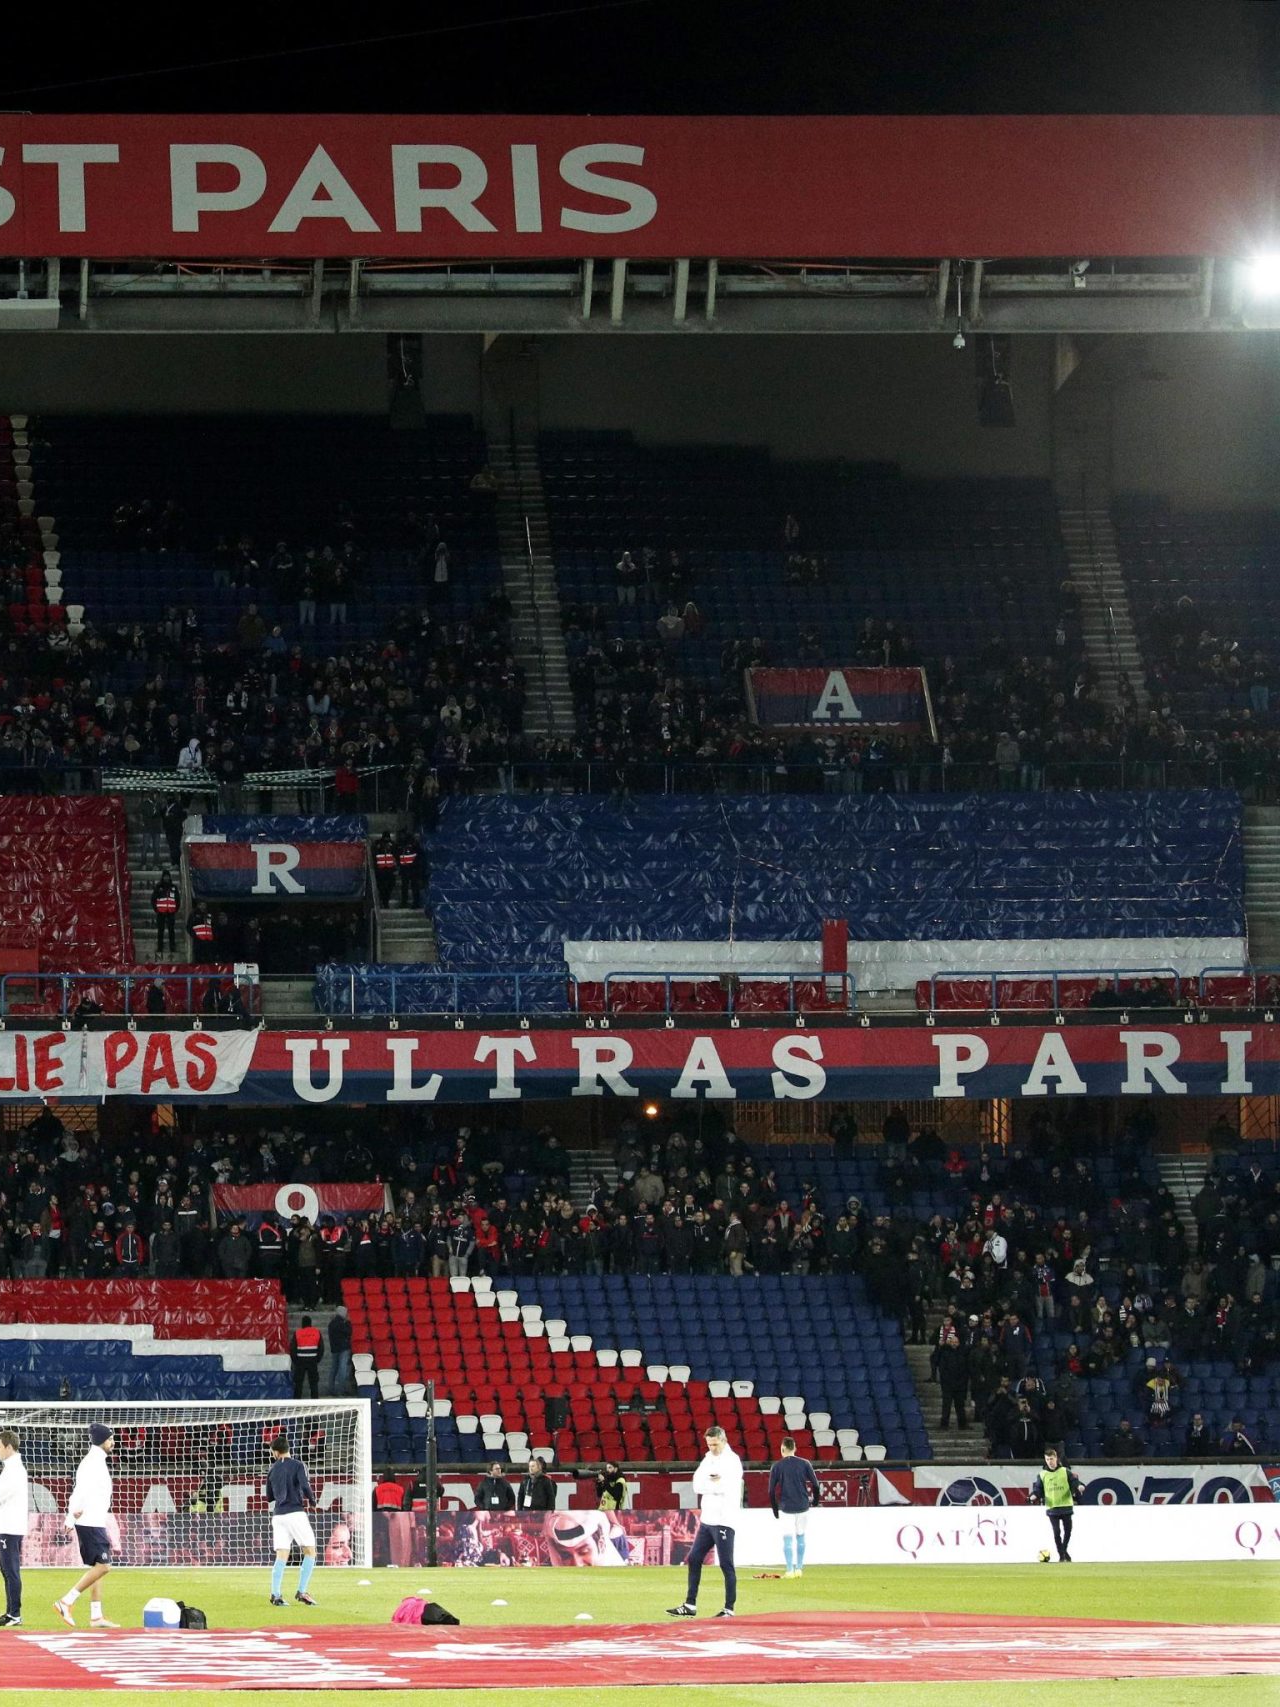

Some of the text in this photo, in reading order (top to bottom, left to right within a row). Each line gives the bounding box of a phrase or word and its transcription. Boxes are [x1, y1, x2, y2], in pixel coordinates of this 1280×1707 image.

[169, 143, 658, 234] PARIS
[812, 670, 862, 719] A
[251, 843, 306, 894] R
[104, 1031, 218, 1093] PAS
[285, 1034, 827, 1103] ULTRAS
